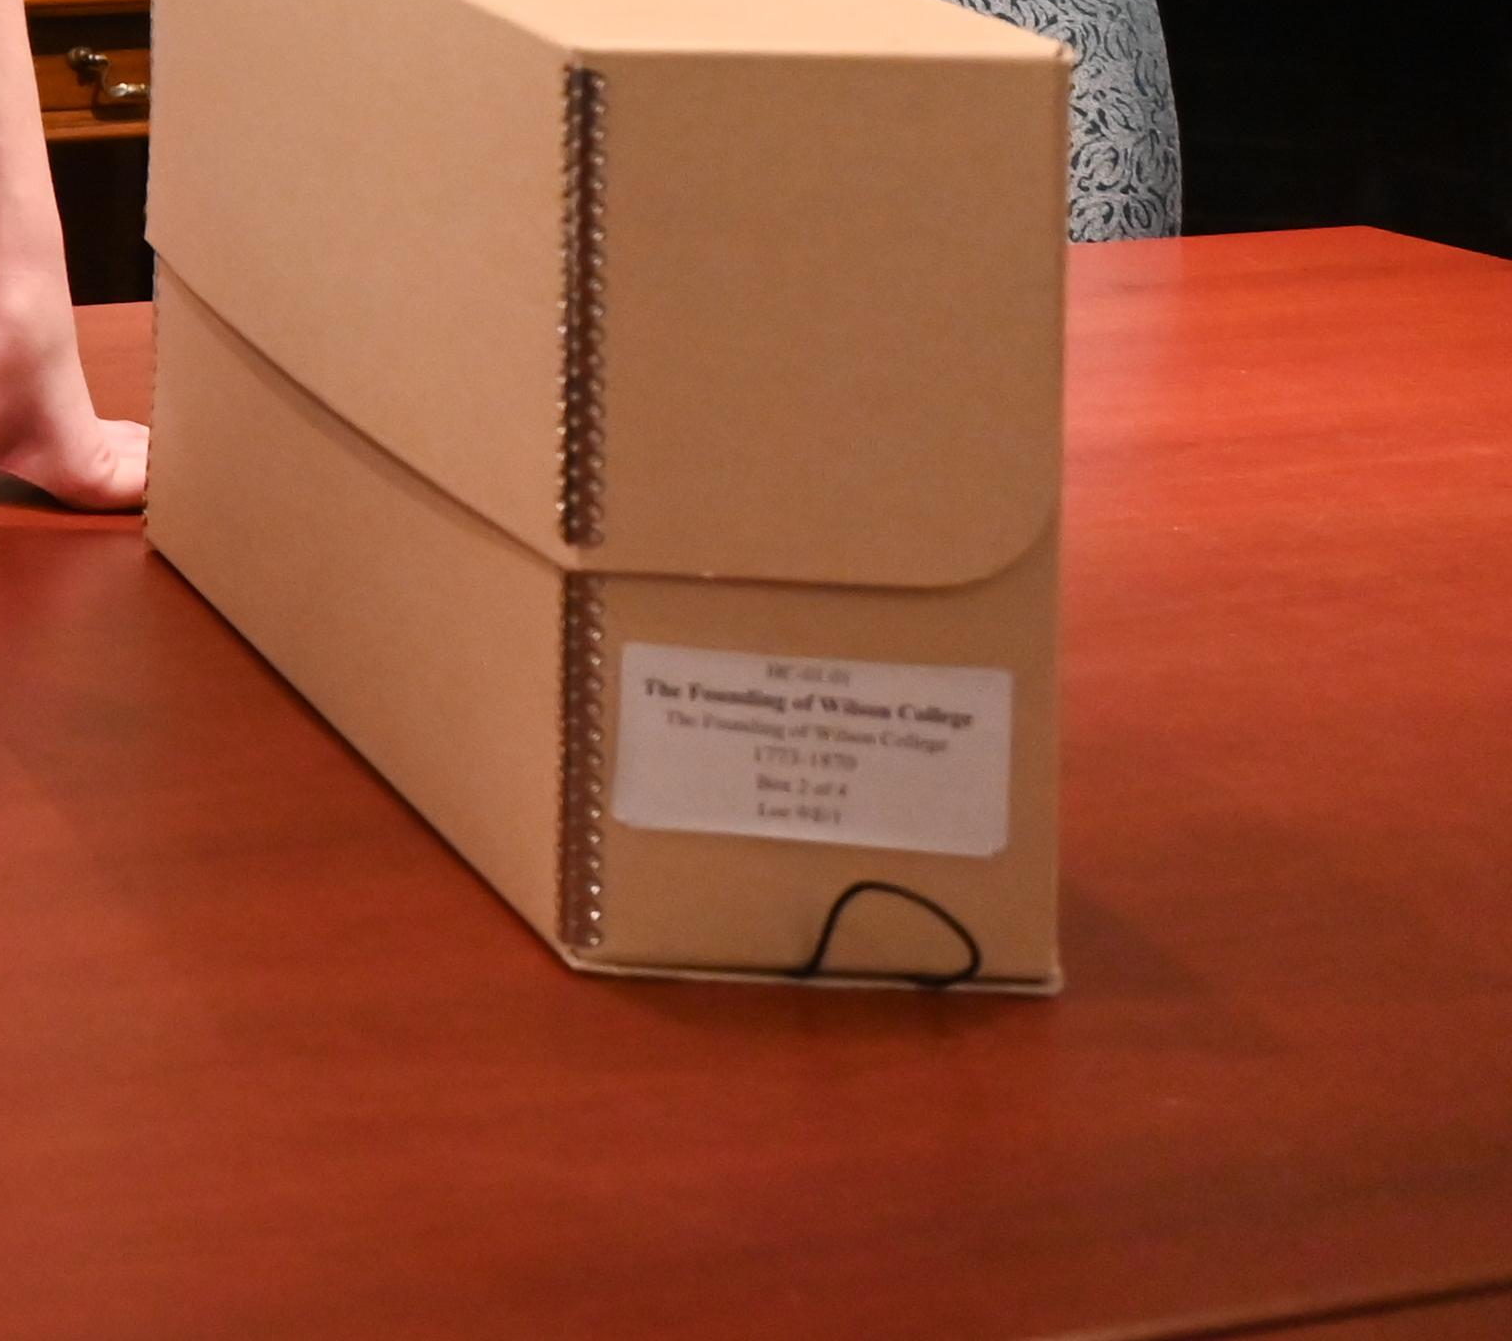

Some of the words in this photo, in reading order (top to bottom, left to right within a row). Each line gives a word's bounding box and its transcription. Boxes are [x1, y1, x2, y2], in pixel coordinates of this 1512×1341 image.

[645, 678, 680, 698] The
[689, 682, 785, 713] Founding
[792, 694, 814, 711] of
[819, 697, 891, 718] Wilson
[898, 704, 973, 730] College
